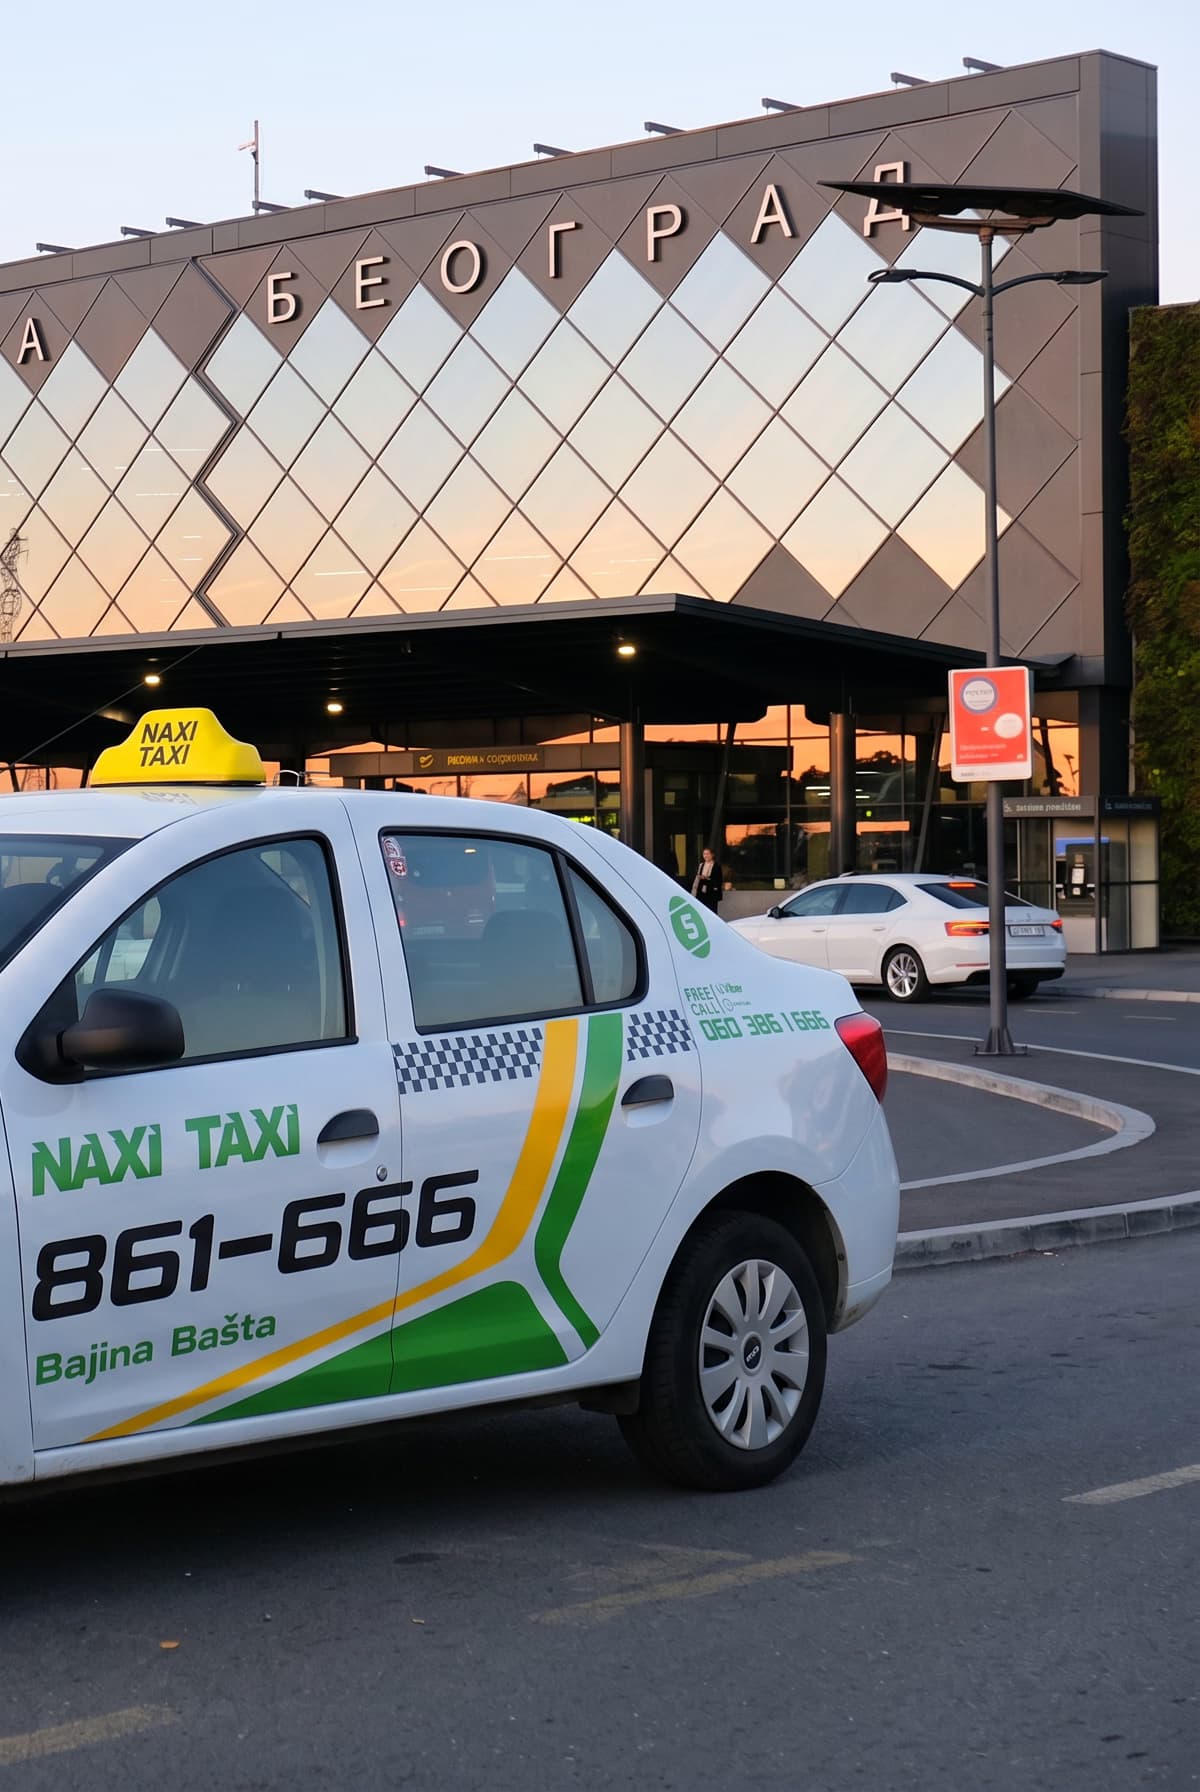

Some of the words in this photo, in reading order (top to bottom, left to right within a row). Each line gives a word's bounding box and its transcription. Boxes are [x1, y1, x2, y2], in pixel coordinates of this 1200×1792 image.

[266, 160, 911, 324] БЕОГРАД
[140, 720, 198, 744] NAXI
[139, 744, 191, 767] TAXI
[684, 986, 714, 1001] FREE
[690, 1001, 720, 1016] CALL
[699, 1017, 743, 1041] 060
[742, 1013, 784, 1036] 386
[790, 1010, 831, 1031] 666
[32, 1123, 163, 1197] NAXI
[185, 1103, 300, 1170] TAXI
[32, 1169, 479, 1322] 861-666
[36, 1340, 154, 1386] Bajina
[171, 1312, 276, 1357] Bašta
